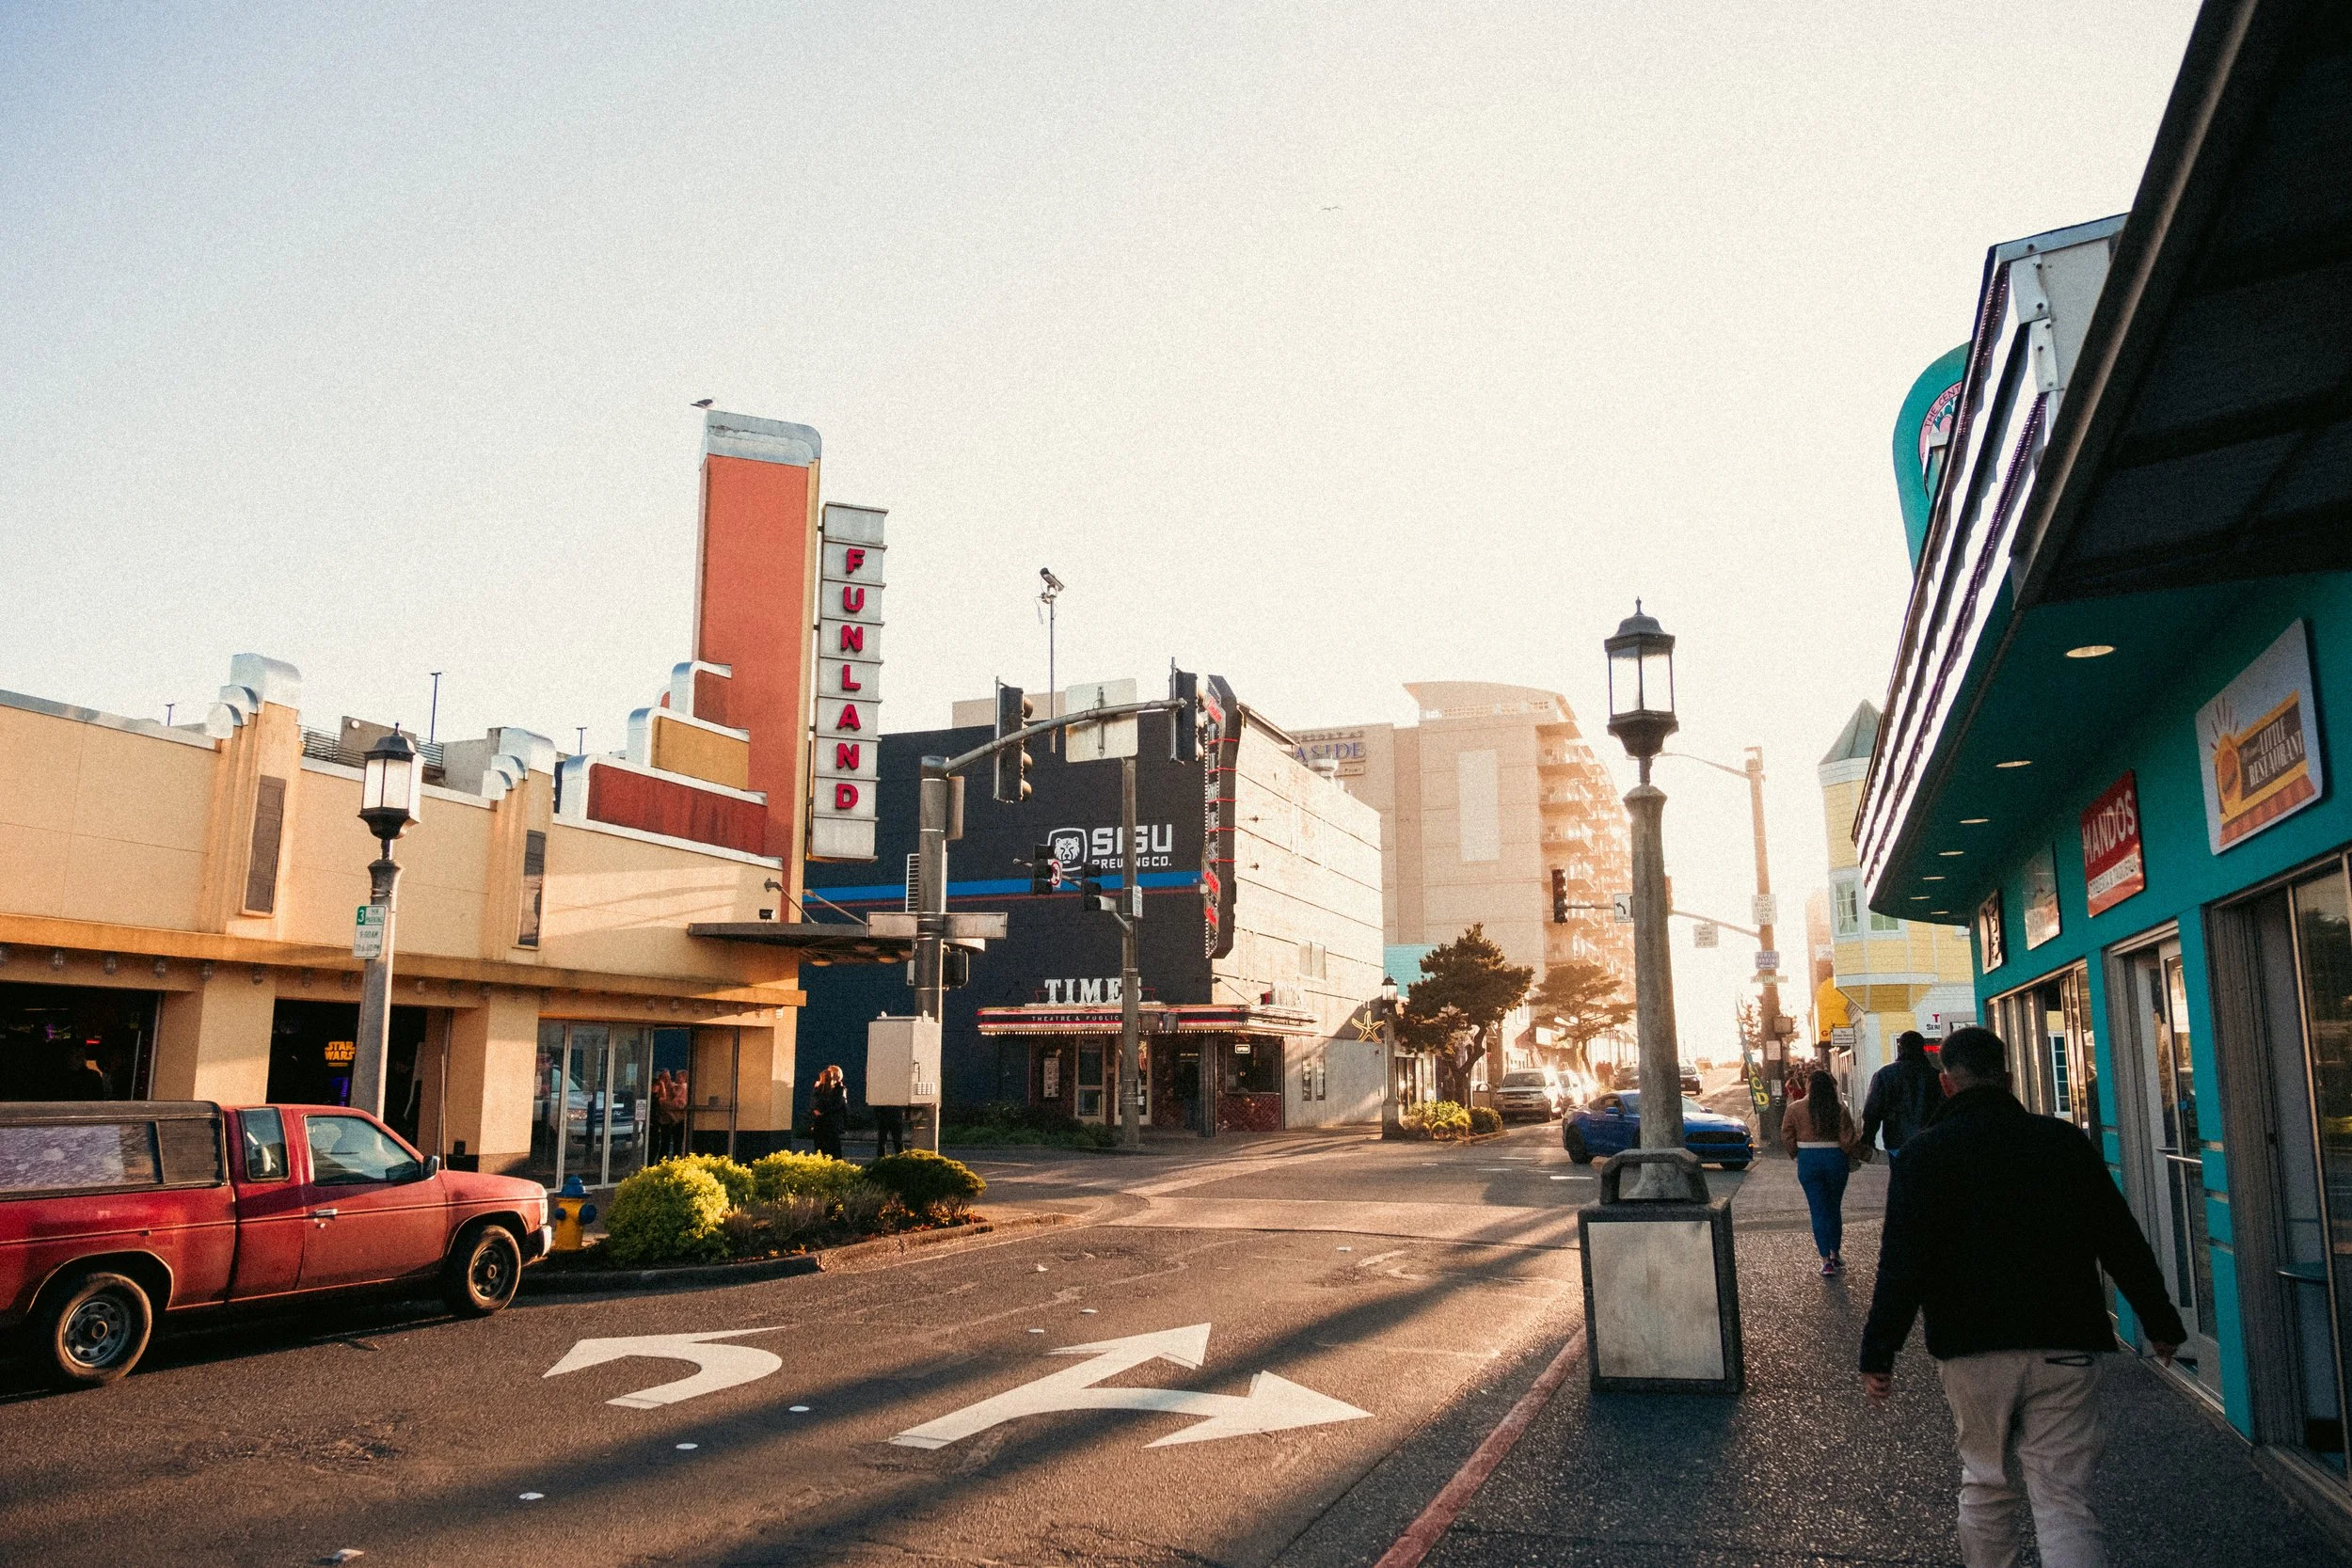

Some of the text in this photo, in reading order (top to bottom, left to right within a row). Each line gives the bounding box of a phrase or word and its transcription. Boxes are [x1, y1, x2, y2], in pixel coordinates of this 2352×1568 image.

[1924, 384, 1963, 428] THE CENT
[835, 548, 866, 810] FUNLAND
[2259, 717, 2285, 755] LITTLE
[1295, 742, 1366, 763] ASIDE
[2249, 729, 2304, 787] RESTAURANT
[1091, 824, 1173, 856] SISU
[2082, 790, 2136, 866] MANDOS
[1152, 856, 1172, 866] CO.
[358, 909, 365, 923] 3
[325, 1040, 356, 1051] STAR
[325, 1051, 356, 1061] WARS
